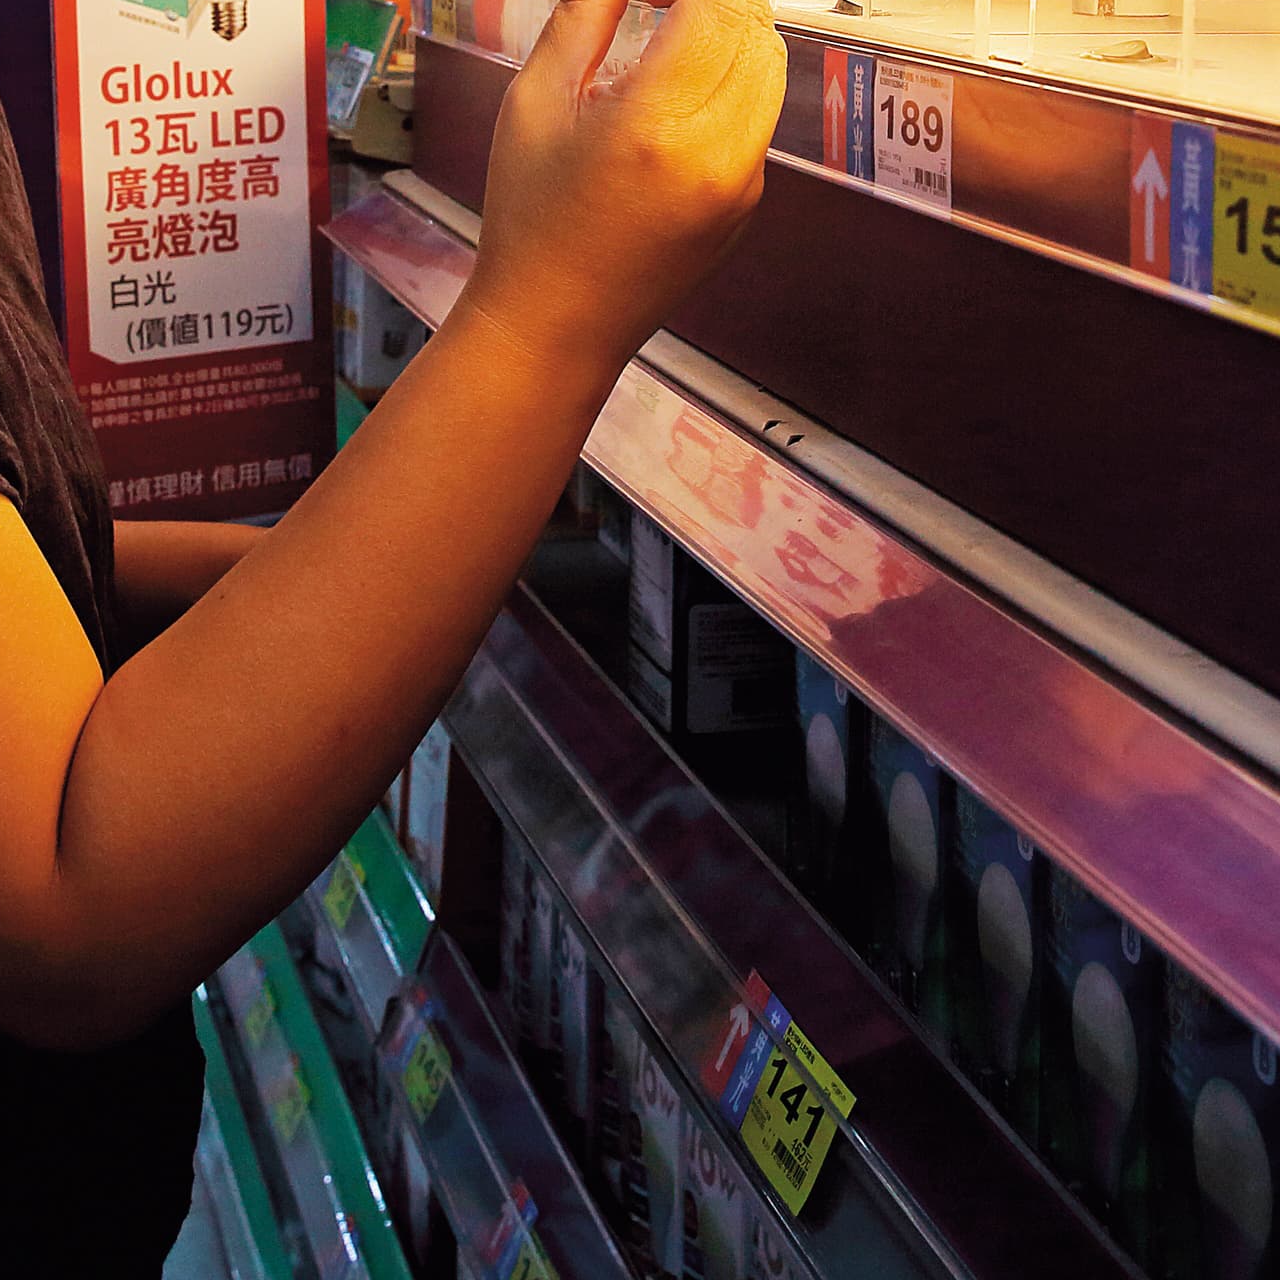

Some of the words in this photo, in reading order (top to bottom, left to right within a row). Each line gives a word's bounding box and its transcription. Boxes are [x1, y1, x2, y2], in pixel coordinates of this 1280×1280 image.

[101, 60, 234, 104] Glolux
[104, 111, 198, 157] 13瓦
[210, 106, 286, 149] LED
[880, 94, 944, 153] 189
[105, 154, 280, 213] 廣角度高
[107, 209, 240, 265] 亮燈泡
[110, 270, 177, 310] 白光
[126, 303, 293, 355] (價值119元)
[211, 453, 312, 492] 信用無價
[767, 1058, 825, 1149] 141
